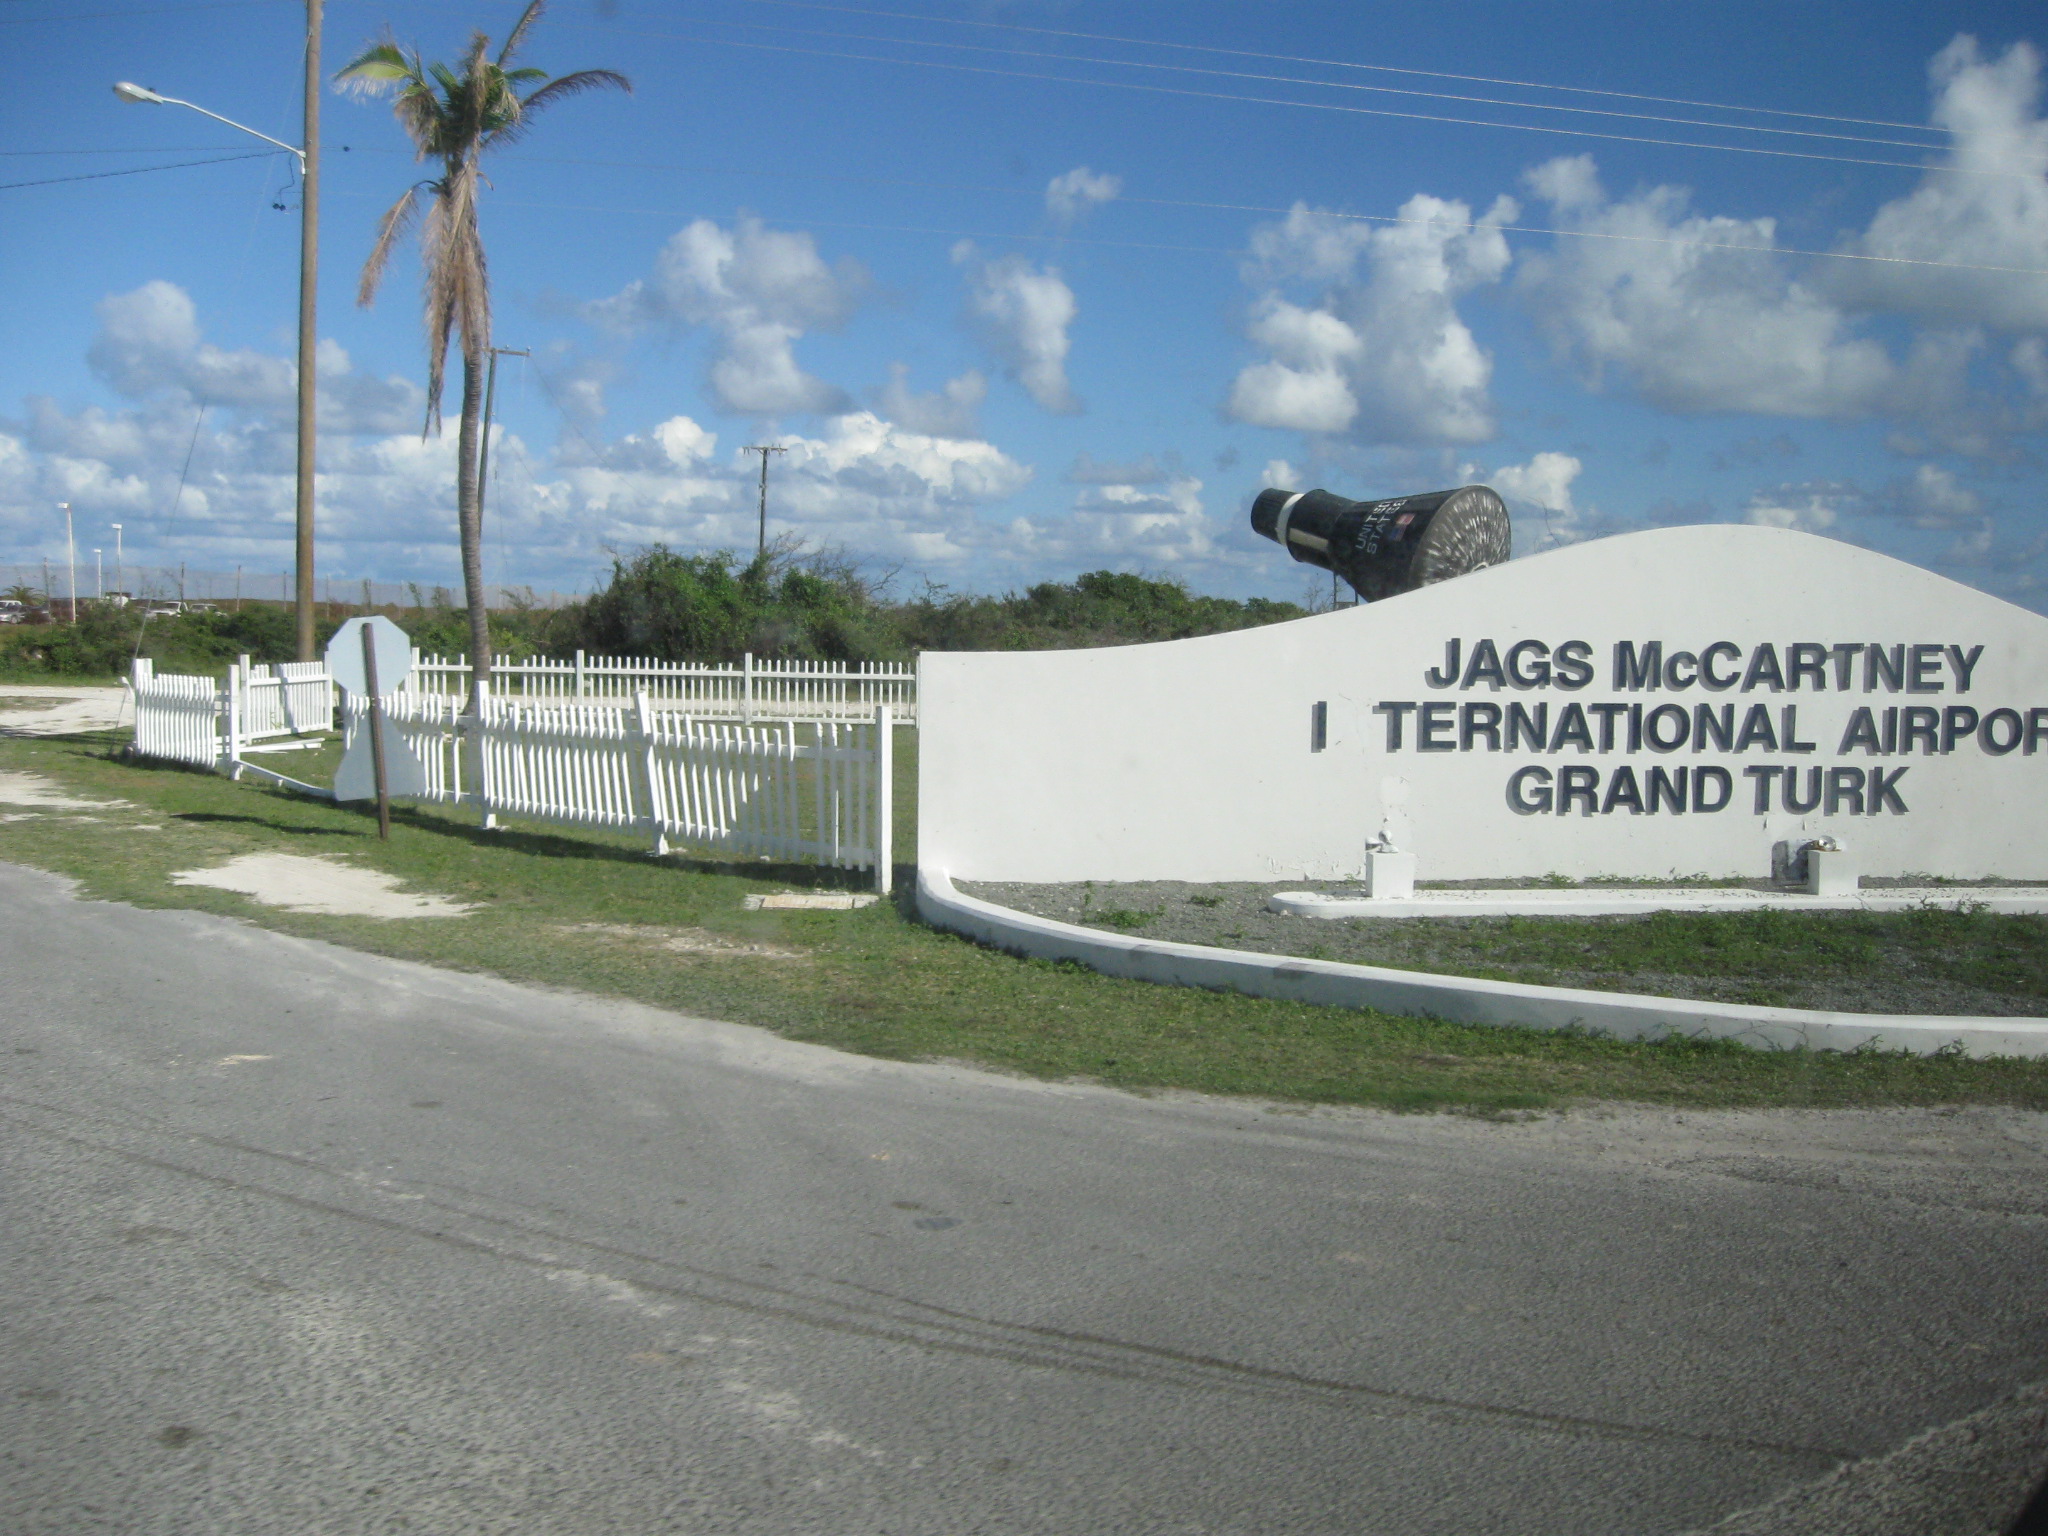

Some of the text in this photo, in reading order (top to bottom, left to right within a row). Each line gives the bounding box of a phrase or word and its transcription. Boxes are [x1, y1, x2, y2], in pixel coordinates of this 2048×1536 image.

[1355, 501, 1393, 549] UNITED
[1425, 638, 1985, 694] JAGS McCARTNEY
[1506, 765, 1910, 817] GRAND TURK
